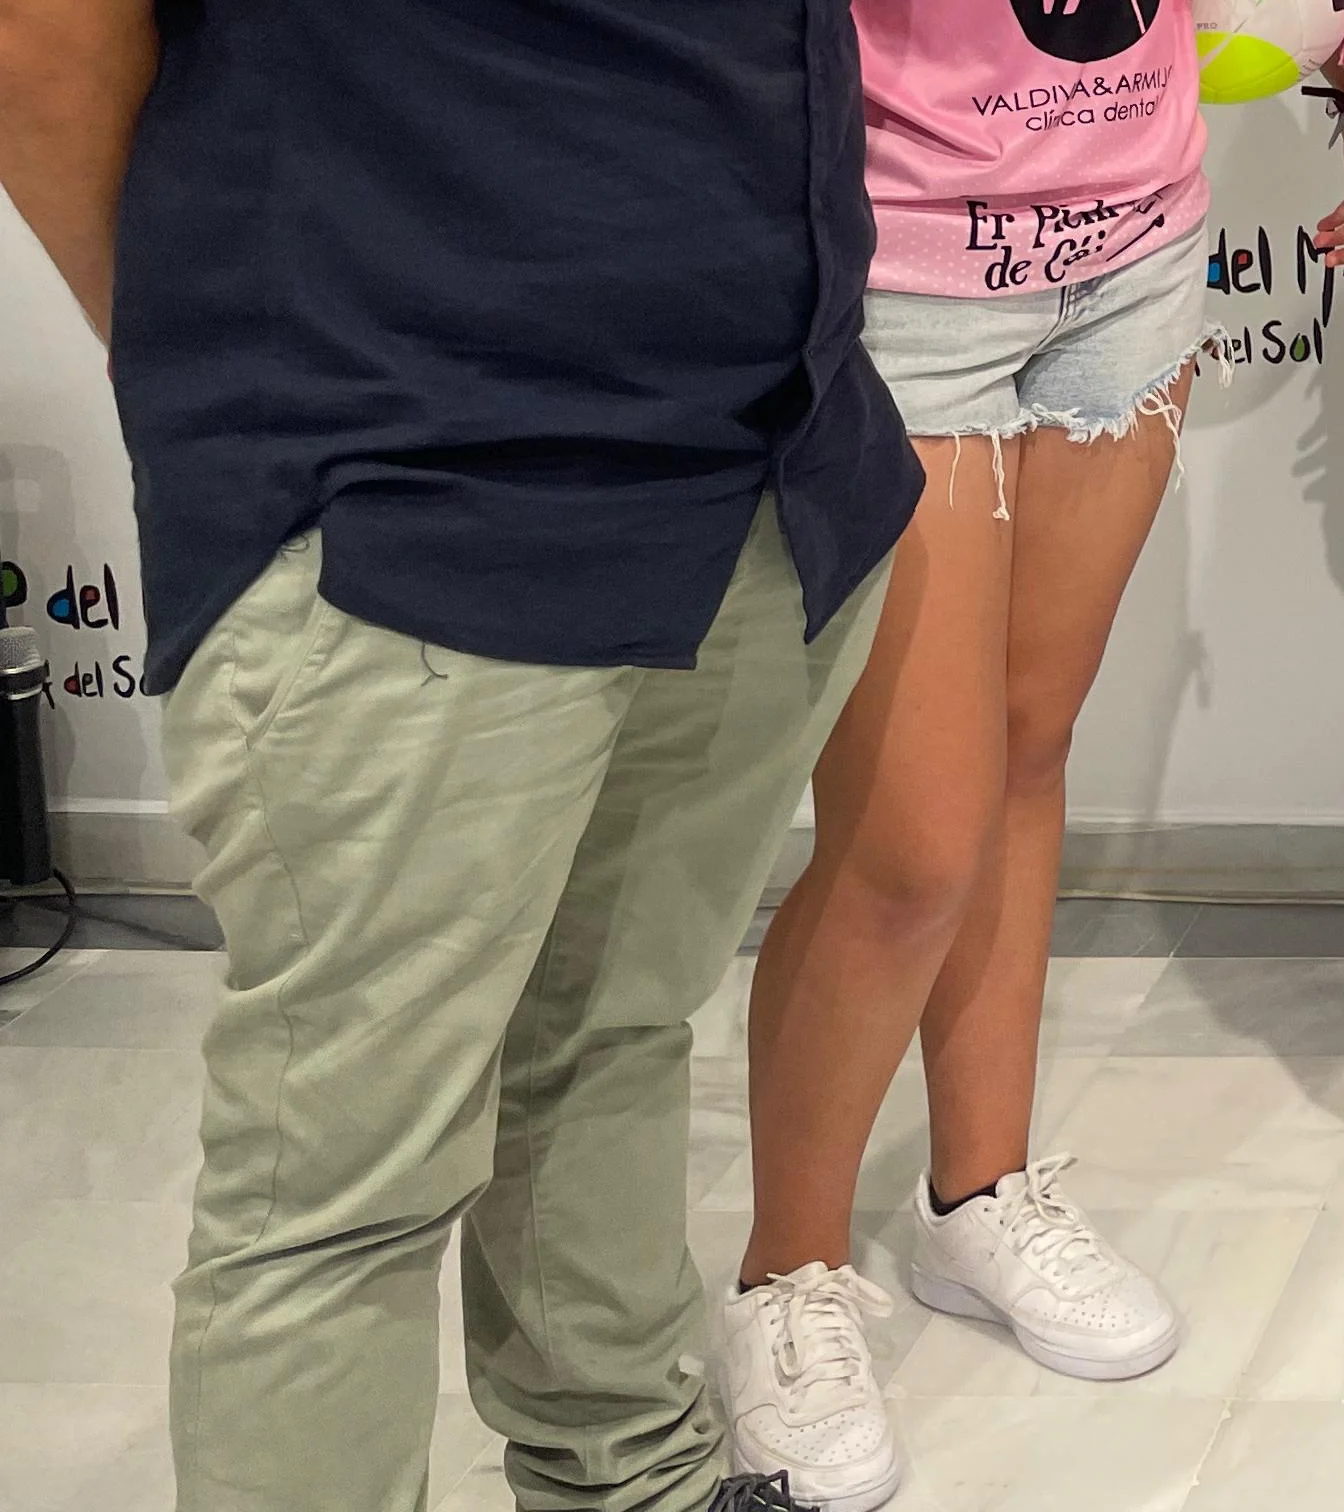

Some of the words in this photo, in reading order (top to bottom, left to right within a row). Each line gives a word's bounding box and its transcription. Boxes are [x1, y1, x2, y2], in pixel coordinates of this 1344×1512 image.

[966, 200, 1015, 251] Er
[985, 246, 1032, 290] de
[1207, 228, 1277, 295] del
[1262, 319, 1323, 365] Sol
[47, 563, 119, 630] del
[64, 661, 104, 698] del
